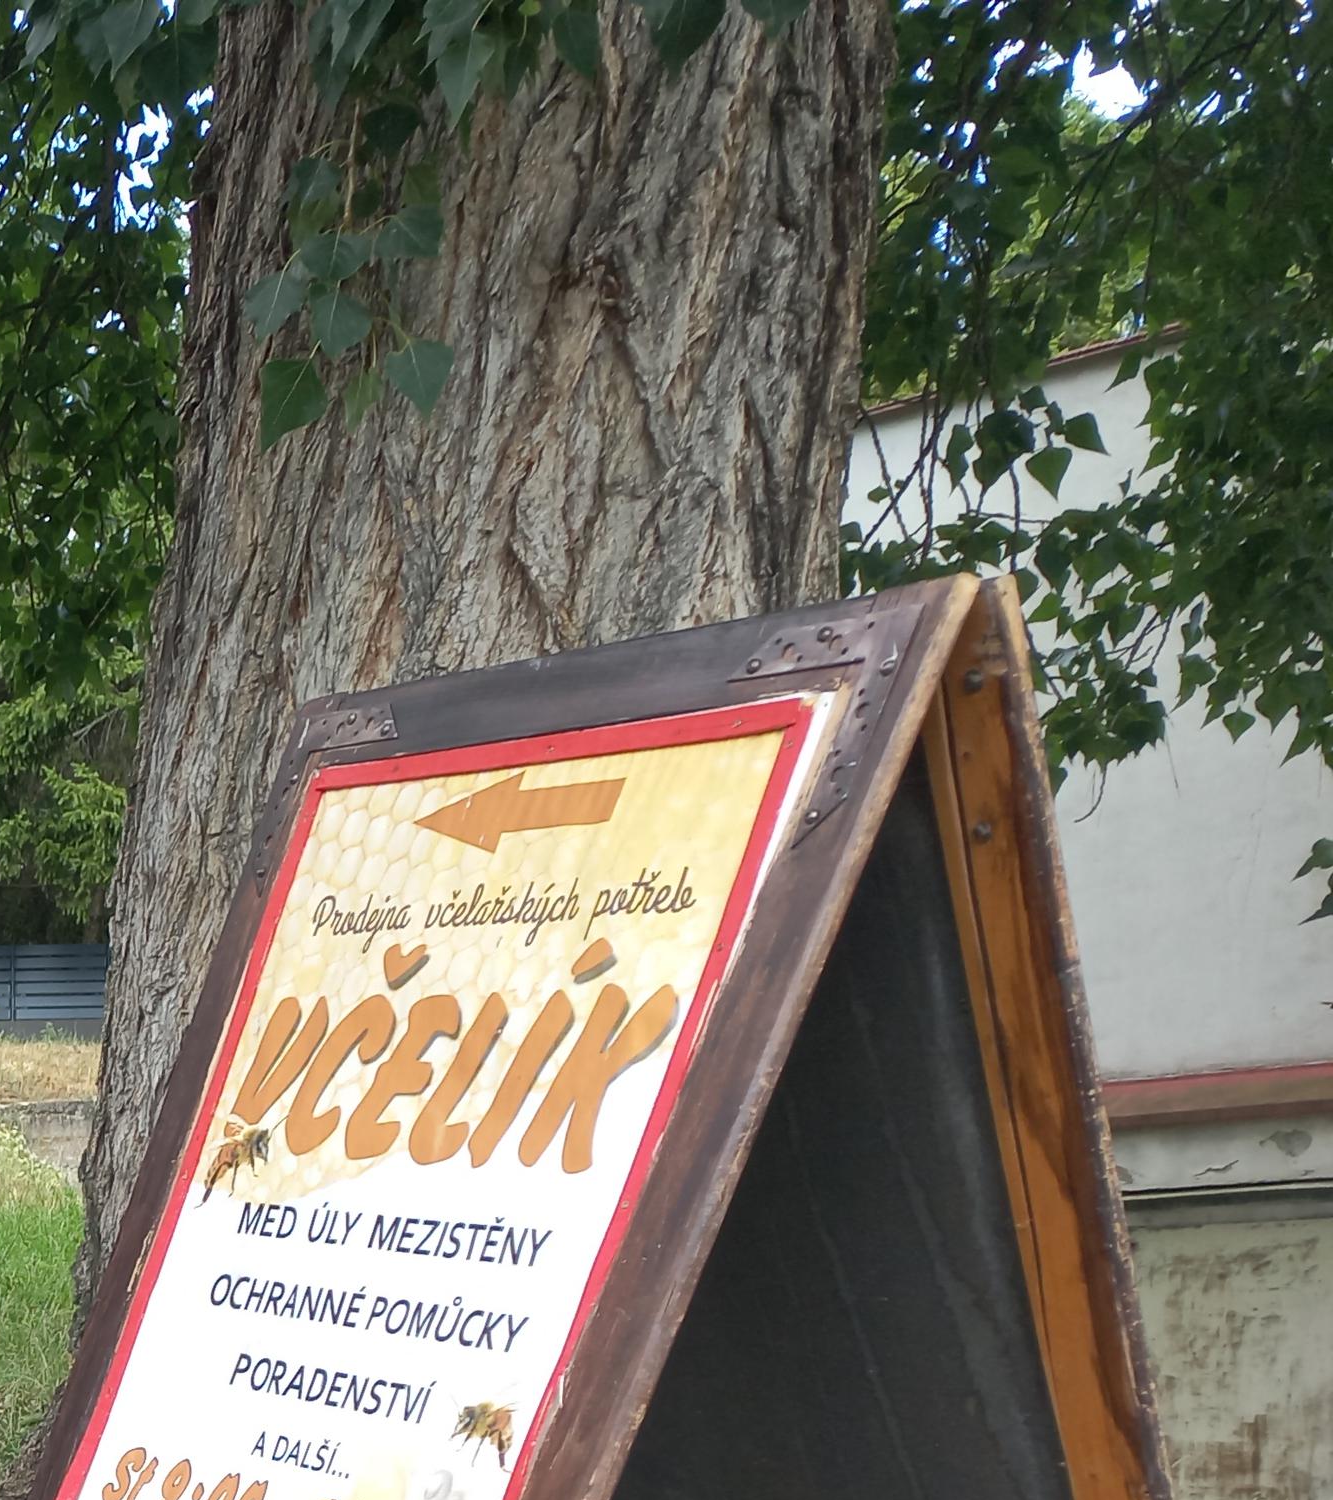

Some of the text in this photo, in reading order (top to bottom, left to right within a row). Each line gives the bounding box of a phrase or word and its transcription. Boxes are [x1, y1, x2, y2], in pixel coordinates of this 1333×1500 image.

[313, 867, 697, 953] Prodejna včelařských potřeb
[232, 937, 679, 1174] VČELÍK
[237, 1202, 553, 1267] MED ÚLY MEZISTĚNY
[210, 1273, 530, 1353] OCHRANNÉ POMŮCKY
[229, 1353, 437, 1424] PORADENSTVÍ
[251, 1431, 350, 1479] A DALŠÍ...
